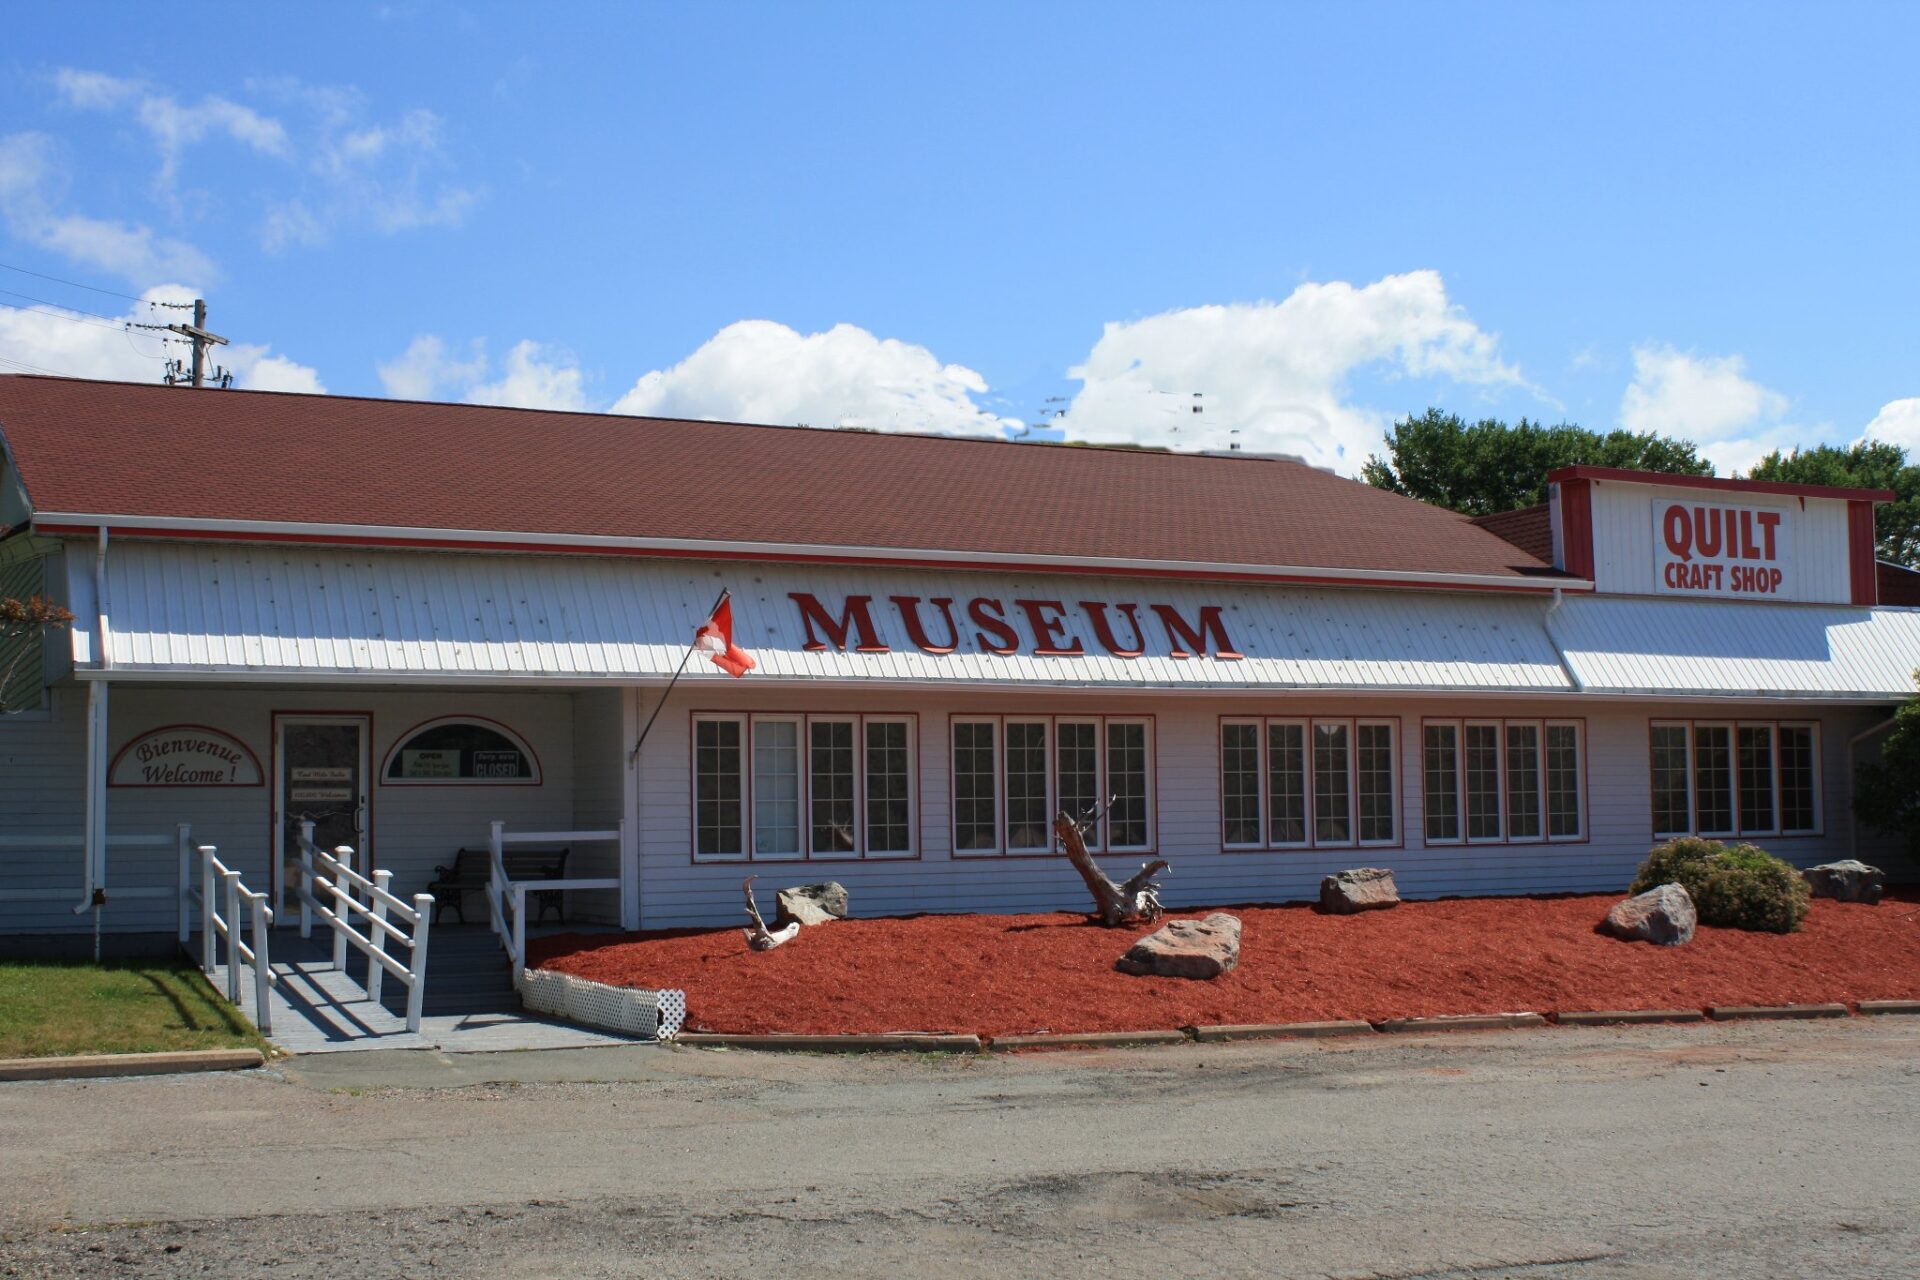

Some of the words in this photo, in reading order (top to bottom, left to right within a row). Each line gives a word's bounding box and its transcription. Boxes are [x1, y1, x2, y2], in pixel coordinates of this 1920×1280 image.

[1663, 505, 1780, 562] QUILT
[1664, 562, 1724, 591] CRAFT
[1730, 565, 1783, 594] SHOP
[787, 591, 1245, 660] MUSEUM
[136, 738, 243, 765] Bienvenue
[142, 763, 224, 783] Welcome
[476, 763, 516, 777] CLOSED
